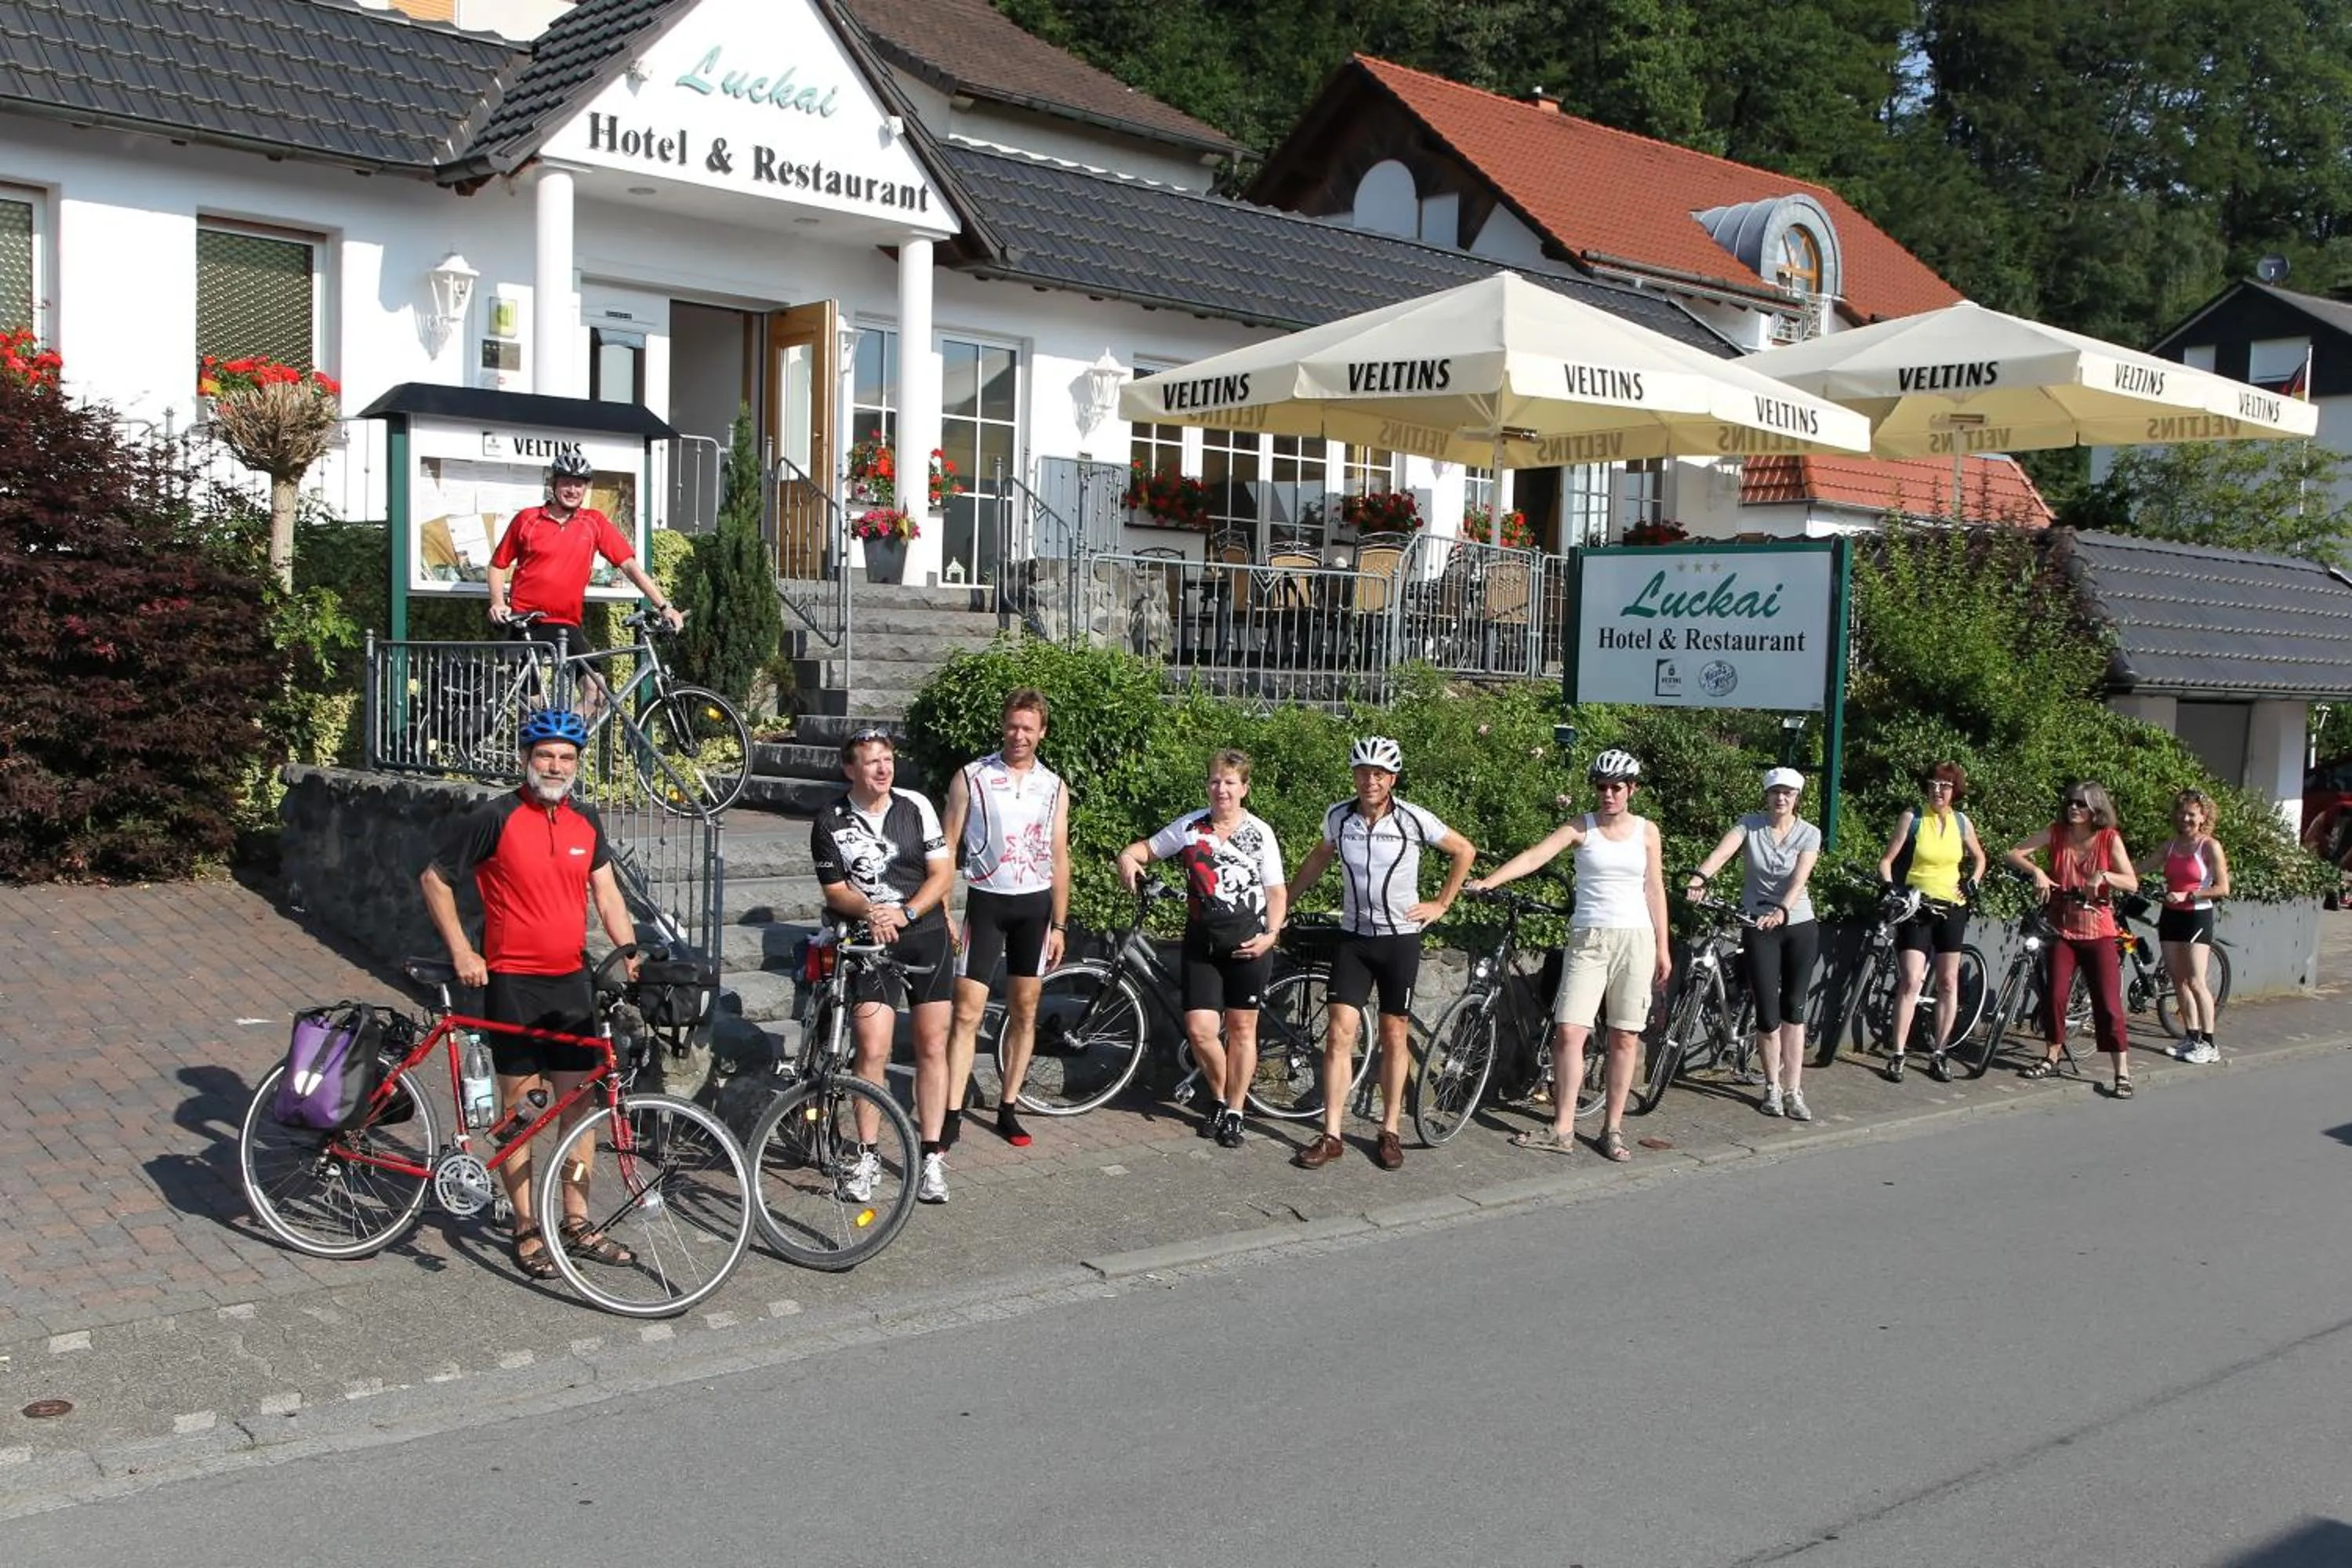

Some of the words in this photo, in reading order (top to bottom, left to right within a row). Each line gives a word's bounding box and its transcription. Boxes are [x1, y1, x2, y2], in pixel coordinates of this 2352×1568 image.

[675, 44, 839, 118] Luckai
[588, 111, 688, 165] Hotel
[706, 136, 734, 176] &
[752, 144, 929, 213] Restaurant
[1163, 372, 1251, 412] VELTINS
[1348, 358, 1451, 394] VELTINS
[1564, 363, 1644, 401] VELTINS
[1898, 361, 1998, 392] VELTINS
[2114, 363, 2166, 396] VELTINS
[1754, 394, 1818, 435] VELTINS
[2238, 391, 2281, 423] VELTINS
[514, 437, 582, 457] VELTINS
[1620, 570, 1784, 619] Luckai
[1598, 627, 1651, 649] Hotel
[1658, 627, 1677, 650] &
[1684, 627, 1806, 652] Restaurant
